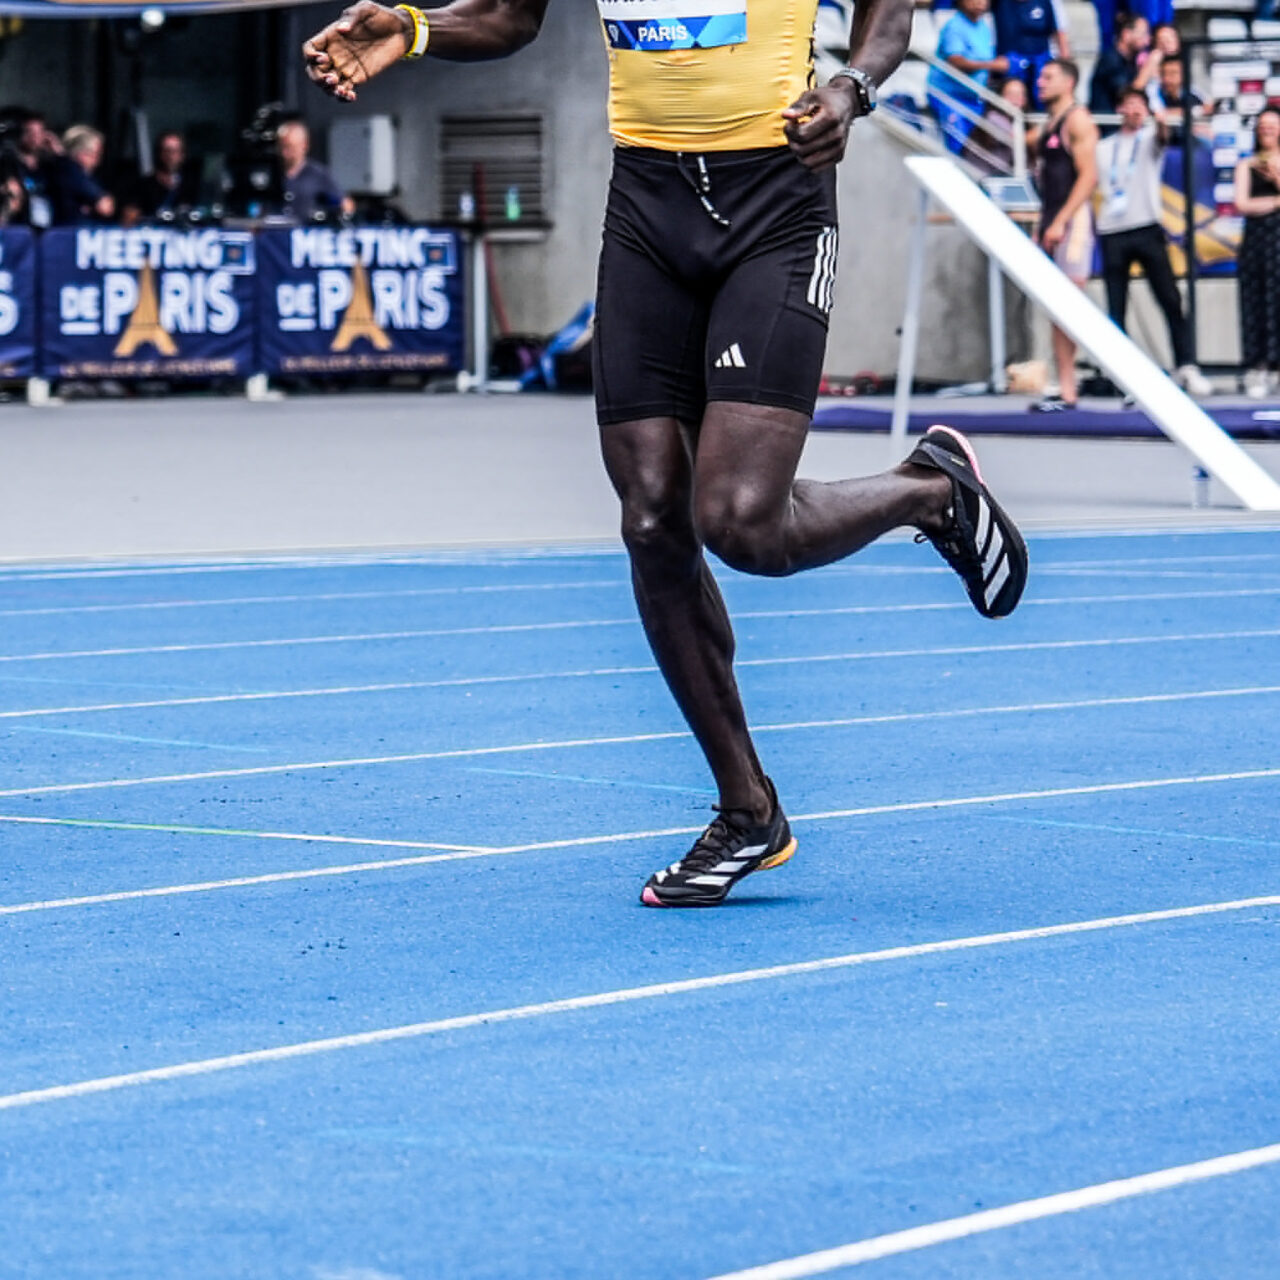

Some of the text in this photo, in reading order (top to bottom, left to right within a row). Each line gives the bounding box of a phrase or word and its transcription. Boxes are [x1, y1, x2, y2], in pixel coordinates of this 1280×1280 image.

[637, 24, 689, 42] PARIS
[76, 229, 221, 269] MEETING
[60, 271, 239, 356] DE PARIS
[276, 268, 450, 351] DE PARIS
